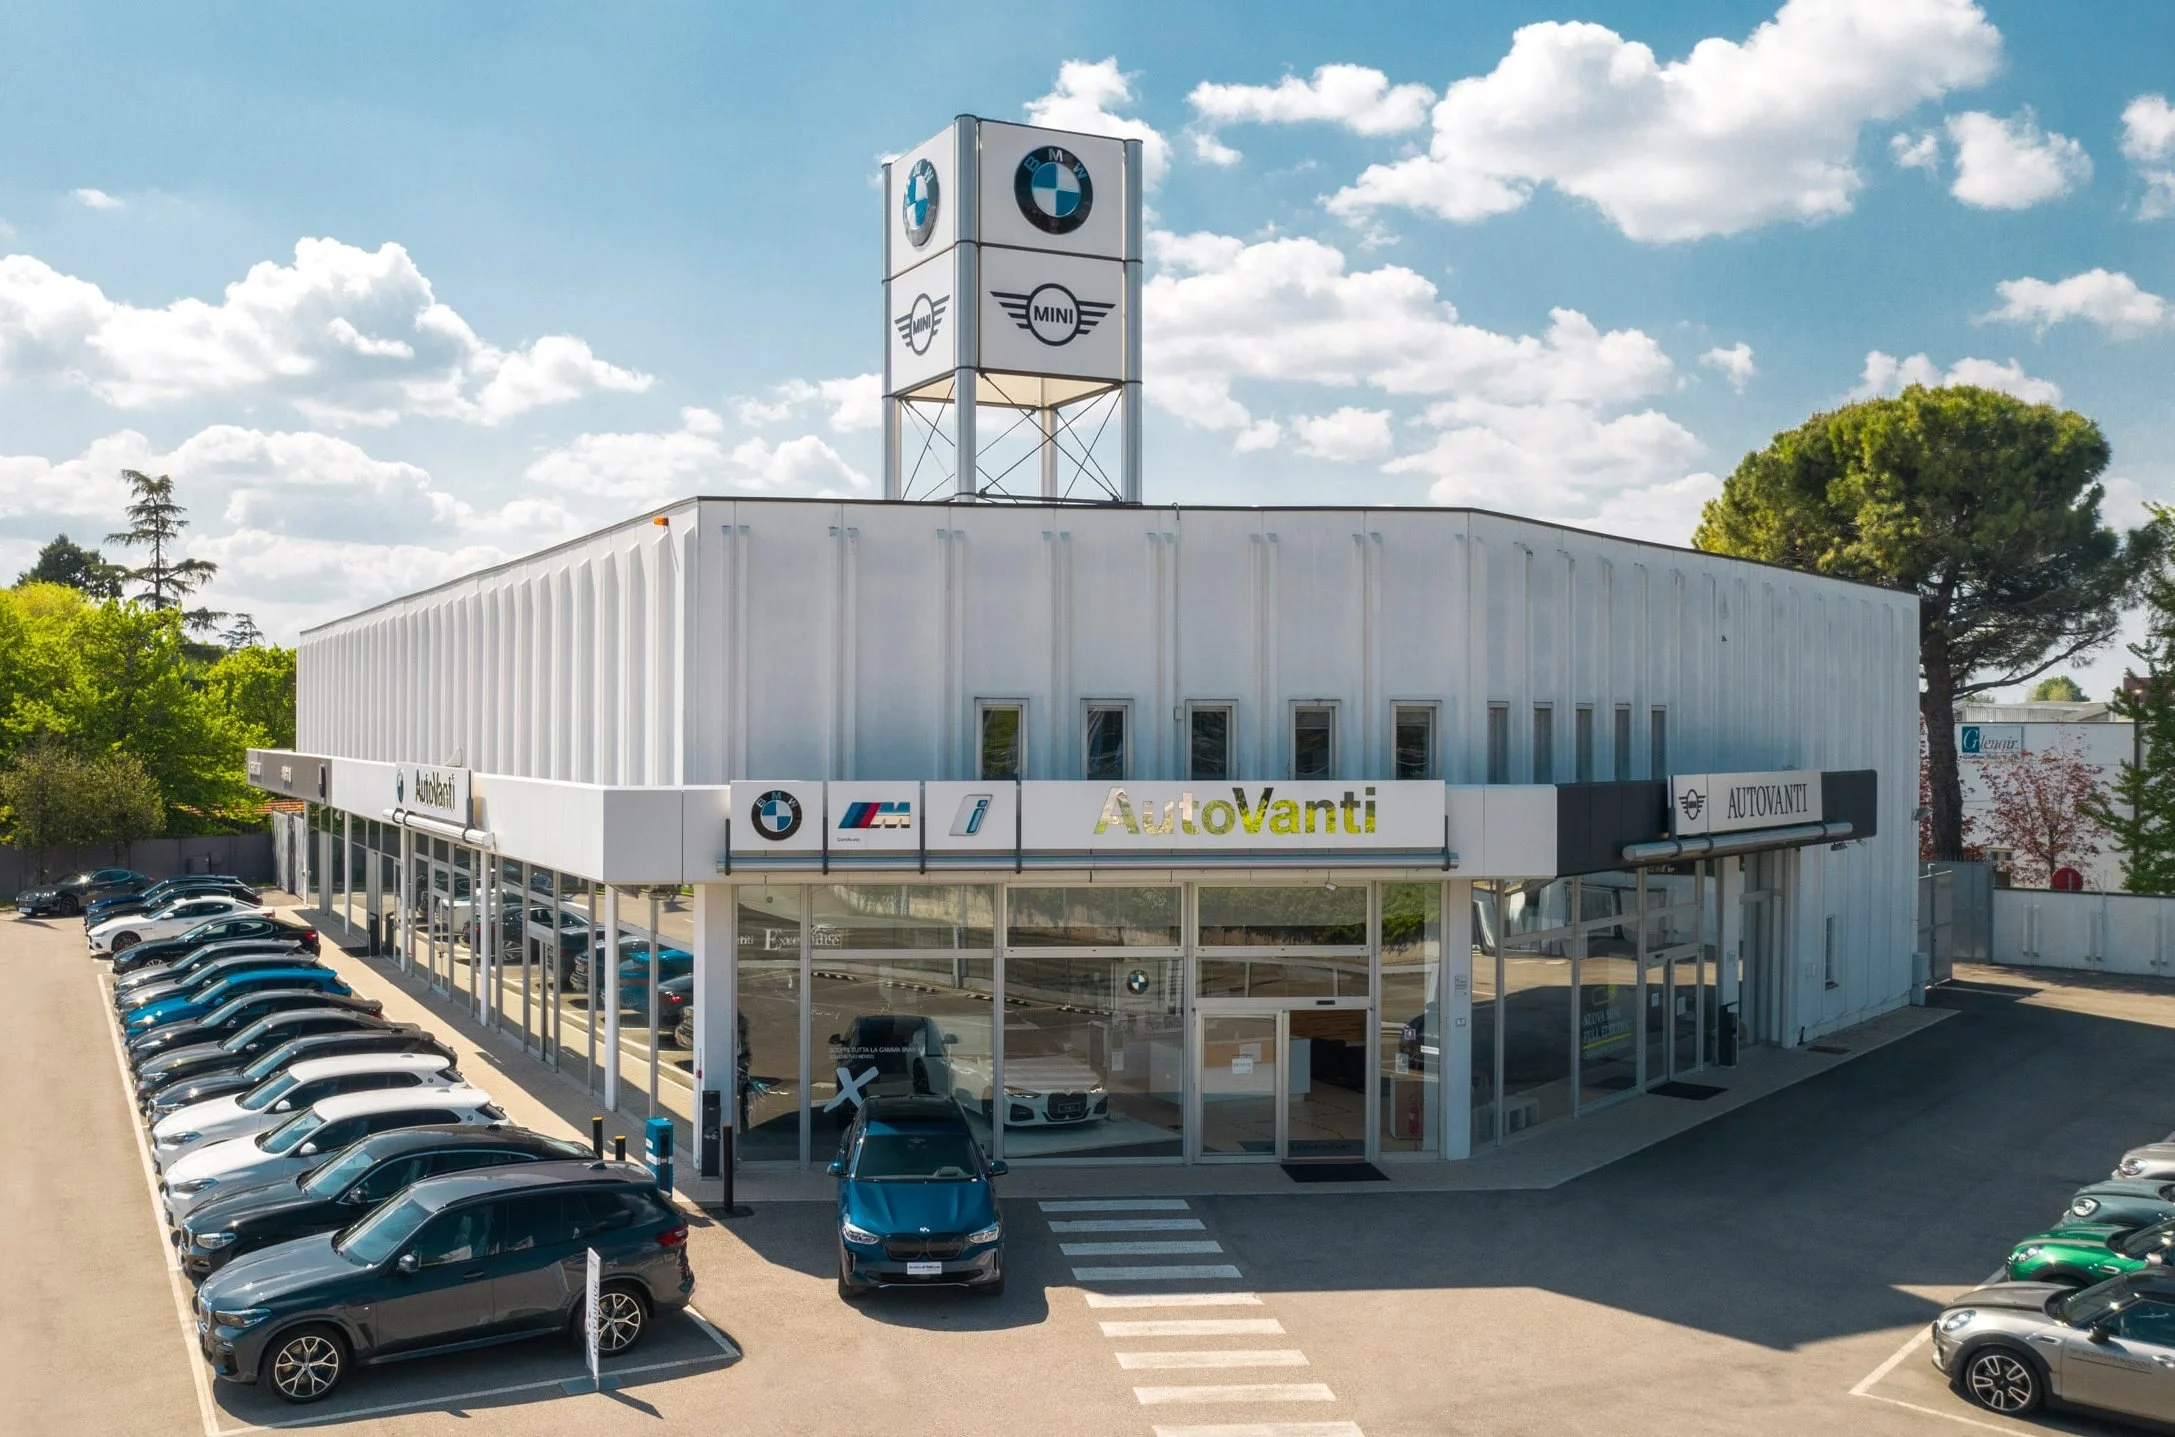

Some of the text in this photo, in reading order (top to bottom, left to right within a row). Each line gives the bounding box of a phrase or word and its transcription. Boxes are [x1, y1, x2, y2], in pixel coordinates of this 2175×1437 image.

[1023, 147, 1087, 180] BMW
[912, 313, 932, 335] MINI
[1033, 304, 1073, 324] MINI
[1963, 728, 2019, 751] Glenair
[415, 768, 456, 811] AutoVanti
[1727, 783, 1808, 819] AUTOVANTI
[1093, 786, 1377, 835] AutoVanti
